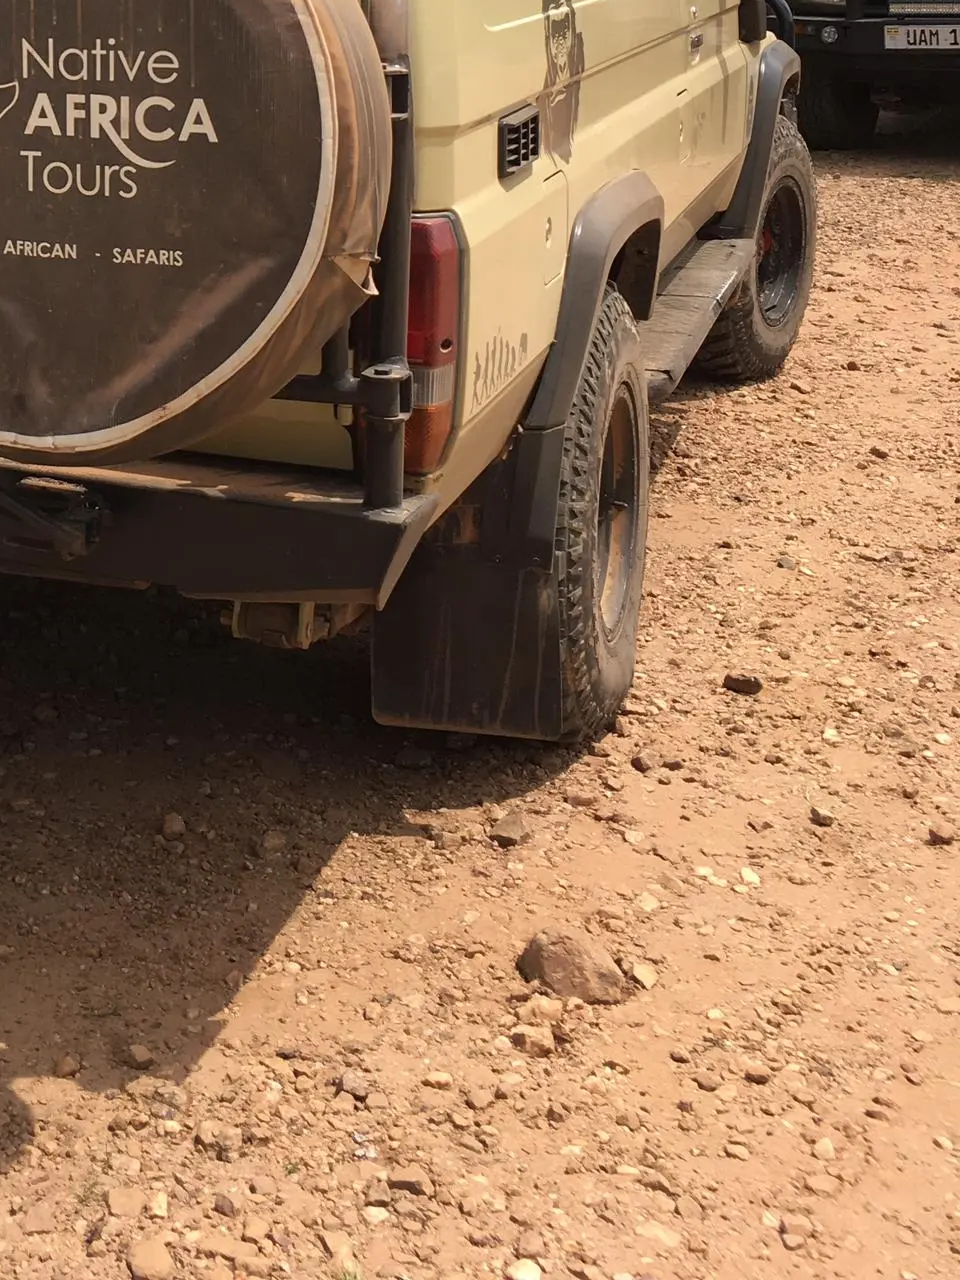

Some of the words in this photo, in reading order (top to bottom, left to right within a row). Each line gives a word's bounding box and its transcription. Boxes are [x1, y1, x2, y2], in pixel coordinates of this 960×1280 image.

[21, 37, 179, 84] Native
[906, 29, 939, 46] UAM
[24, 93, 218, 168] AFRICA
[20, 150, 138, 198] Tours
[3, 239, 77, 260] AFRICAN
[112, 247, 183, 267] SAFARIS
